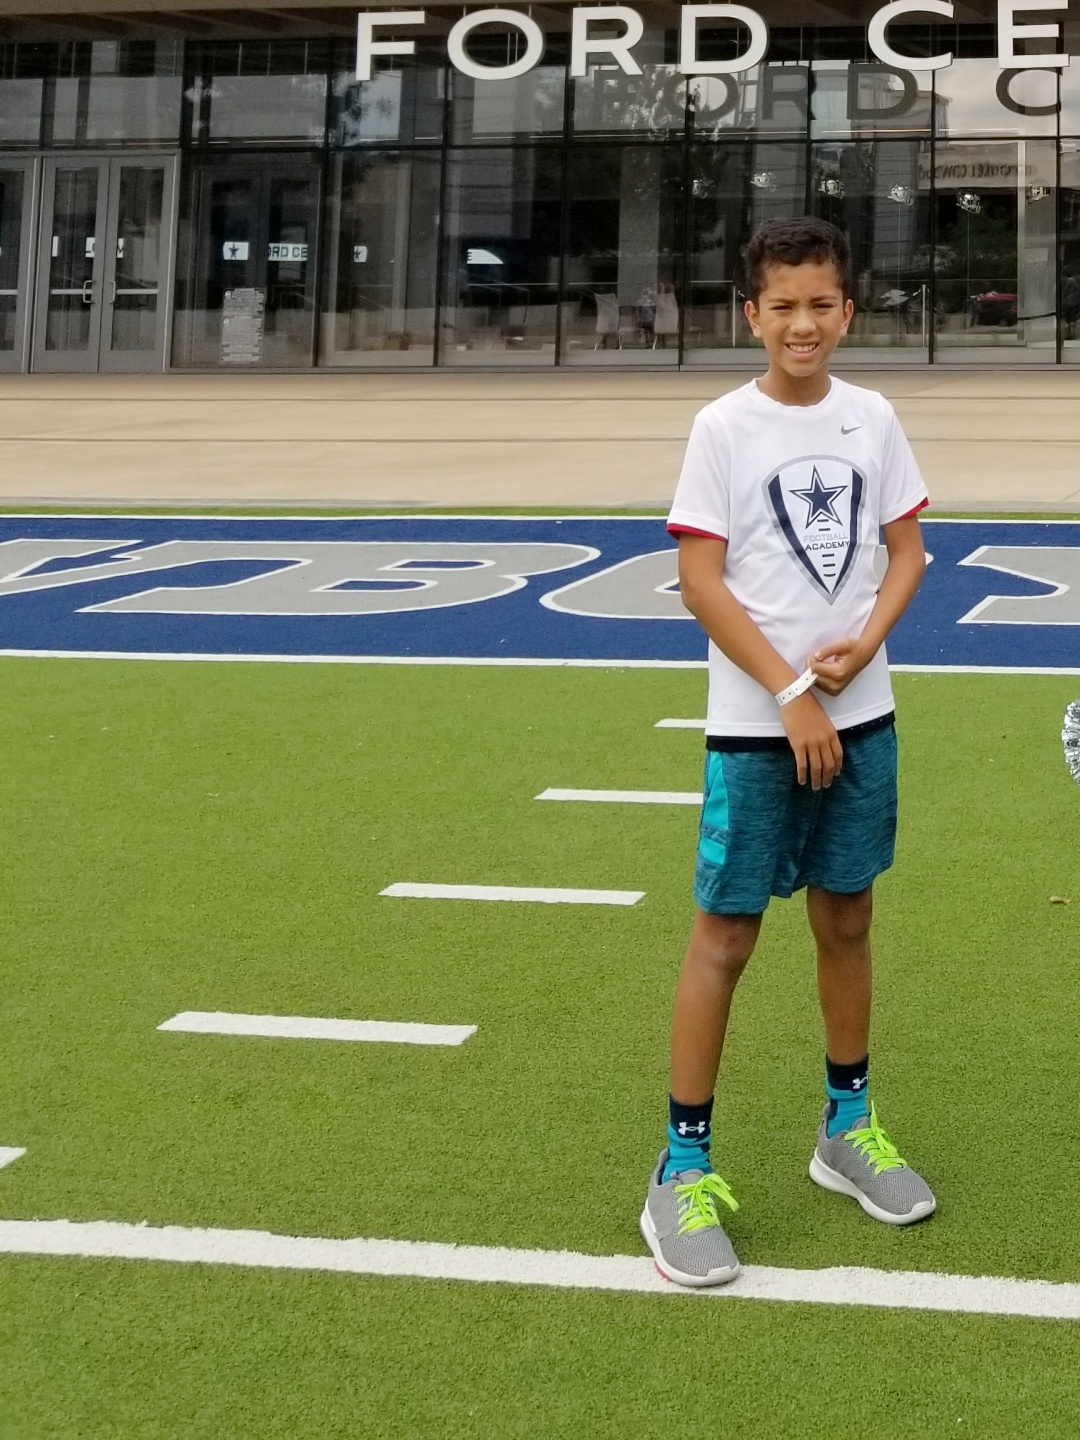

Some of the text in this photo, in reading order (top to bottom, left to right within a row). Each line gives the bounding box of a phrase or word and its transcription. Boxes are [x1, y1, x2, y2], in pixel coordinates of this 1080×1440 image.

[355, 3, 769, 82] FORD
[803, 532, 850, 551] FOOTBALL ACADEMY
